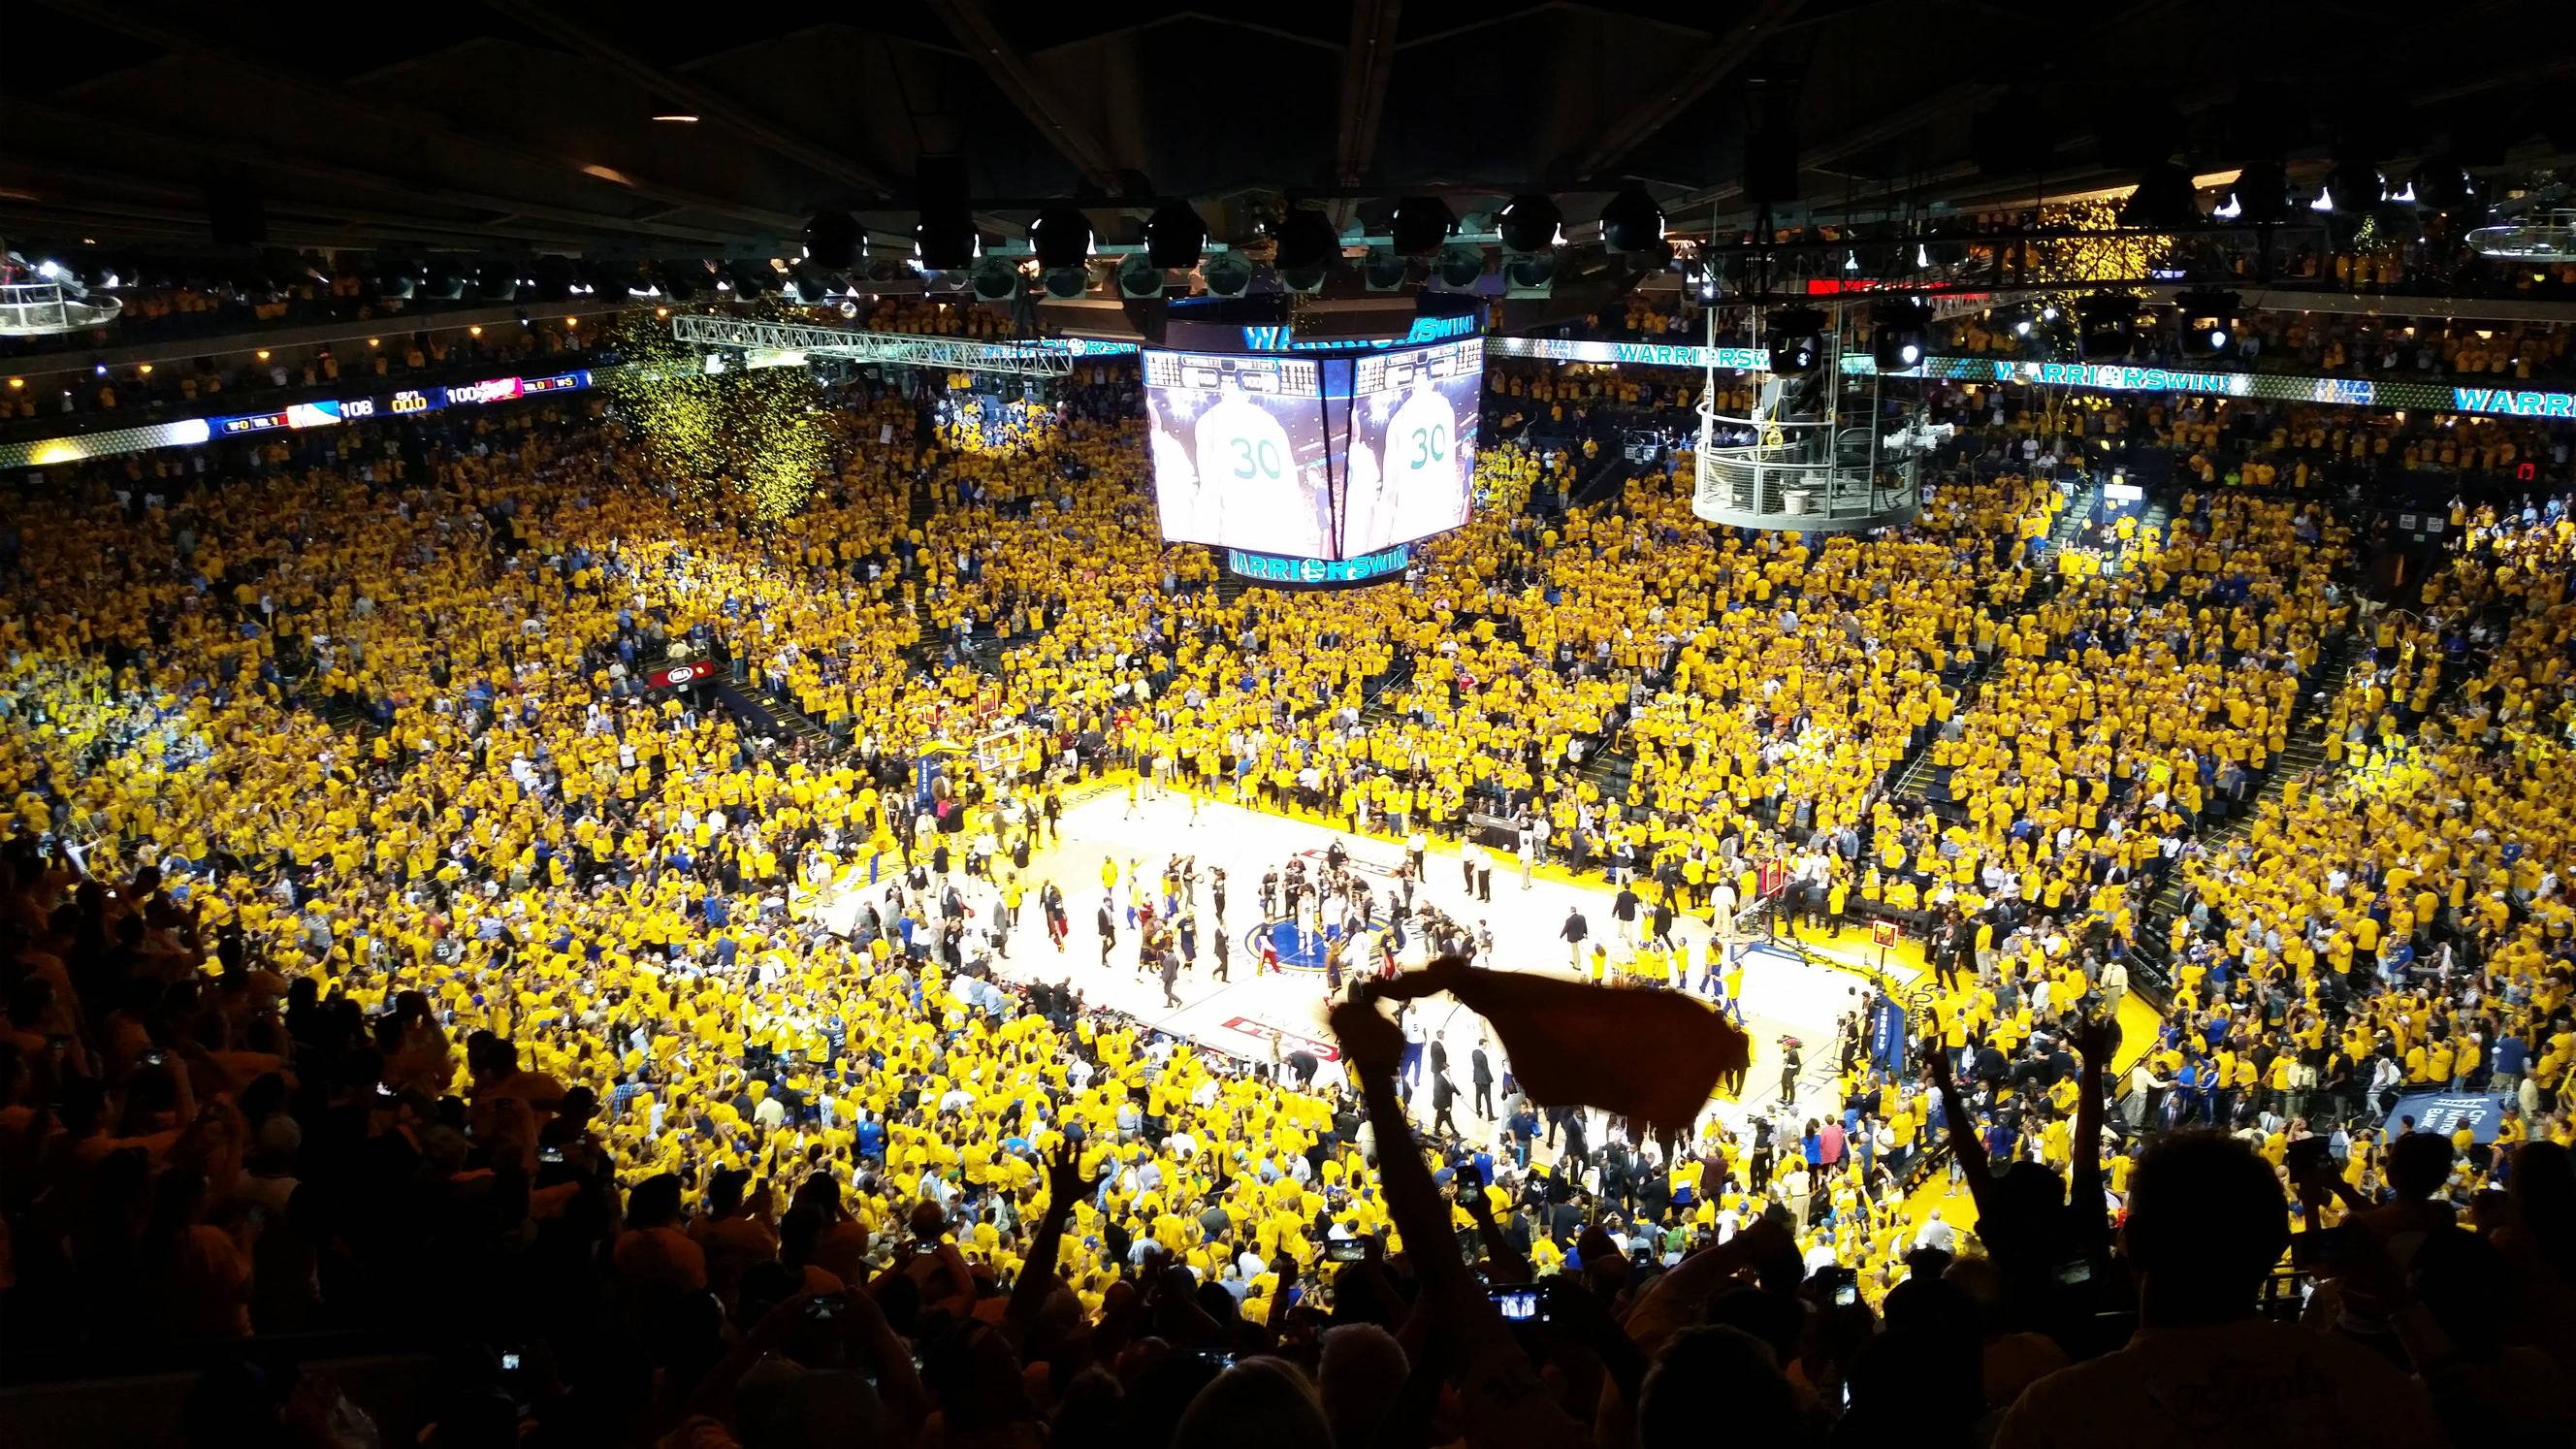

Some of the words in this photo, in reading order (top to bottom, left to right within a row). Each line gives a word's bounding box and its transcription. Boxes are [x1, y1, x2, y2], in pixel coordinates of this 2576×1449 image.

[446, 387, 477, 403] 100
[2455, 388, 2576, 418] WARR
[339, 400, 373, 418] 108
[1409, 423, 1445, 470] 30
[1230, 437, 1281, 480] 30
[436, 948, 450, 957] 23
[1413, 1023, 1419, 1032] 5
